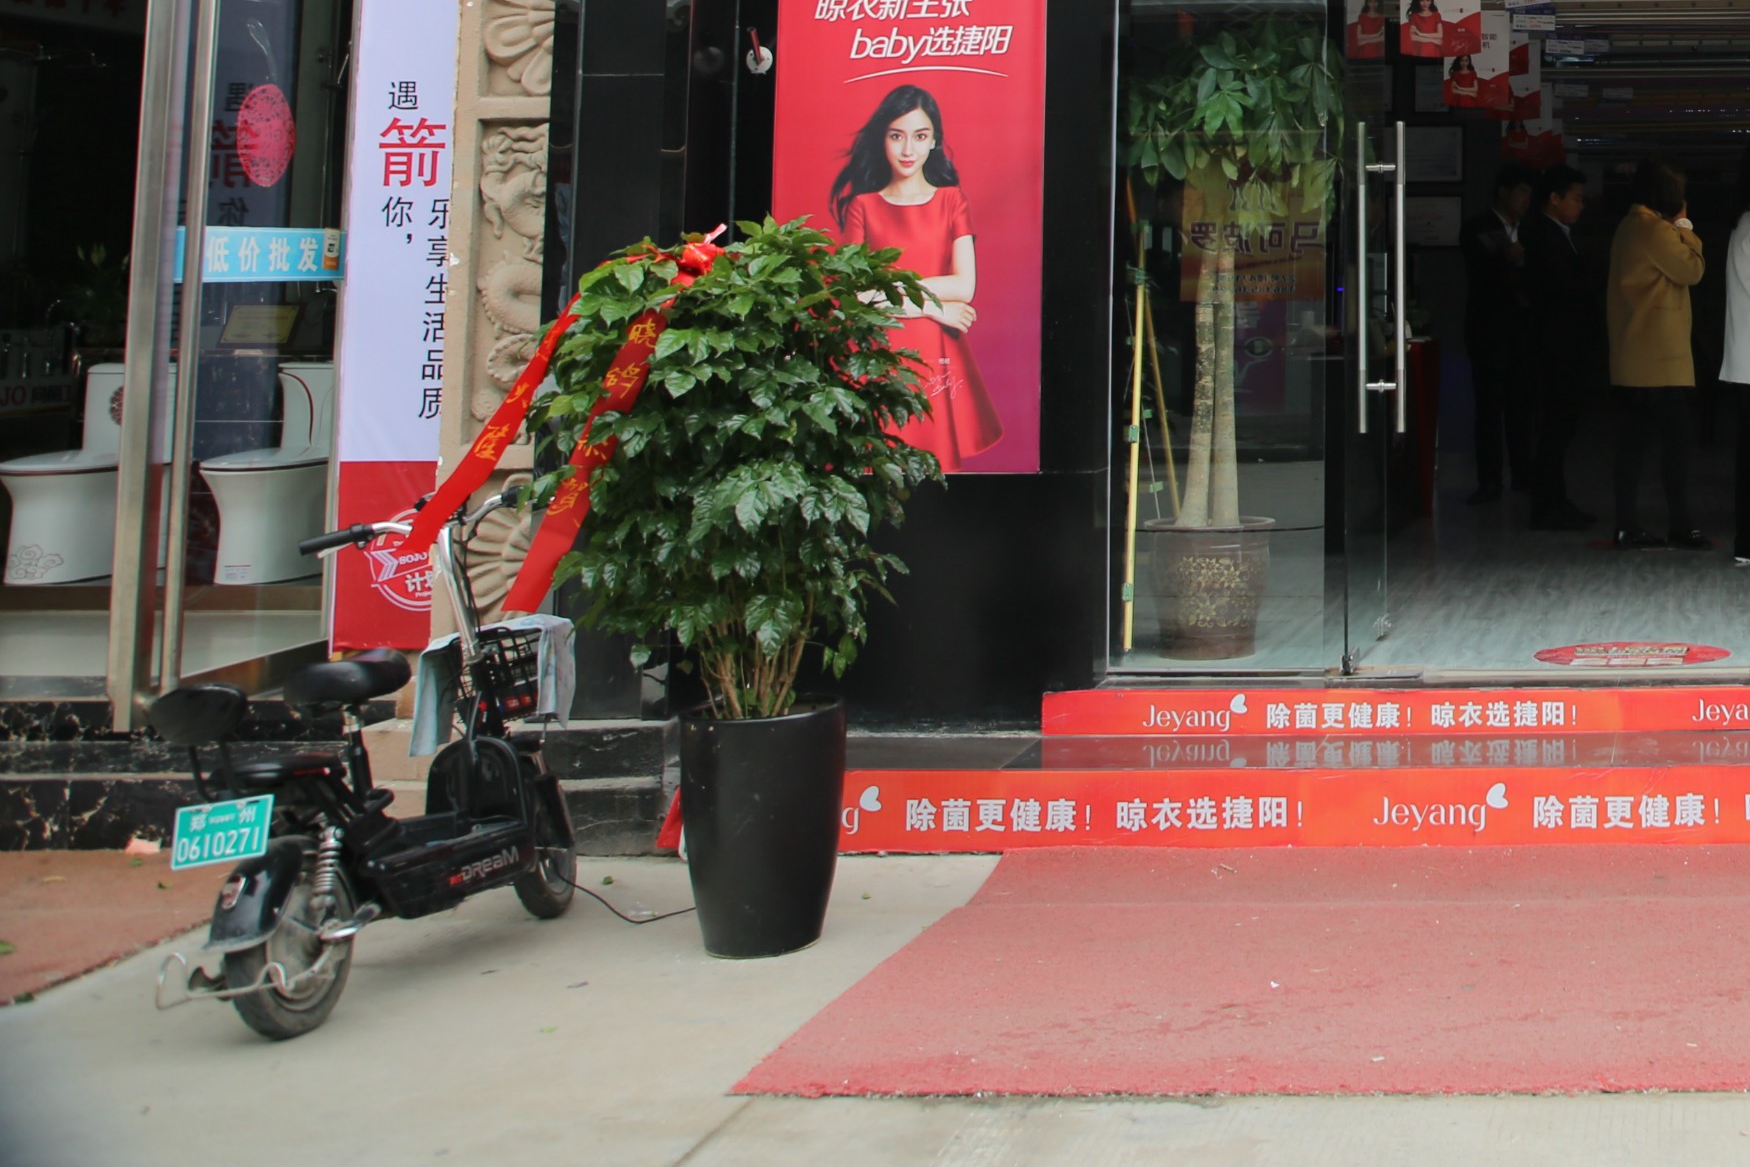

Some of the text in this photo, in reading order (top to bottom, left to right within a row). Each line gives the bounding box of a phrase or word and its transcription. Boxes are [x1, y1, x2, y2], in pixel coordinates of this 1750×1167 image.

[850, 25, 1014, 64] baby选捷阳
[206, 236, 319, 273] 低价批发
[1142, 703, 1231, 731] Jeyang
[1374, 797, 1487, 831] Jeyang
[176, 826, 260, 863] 0610271
